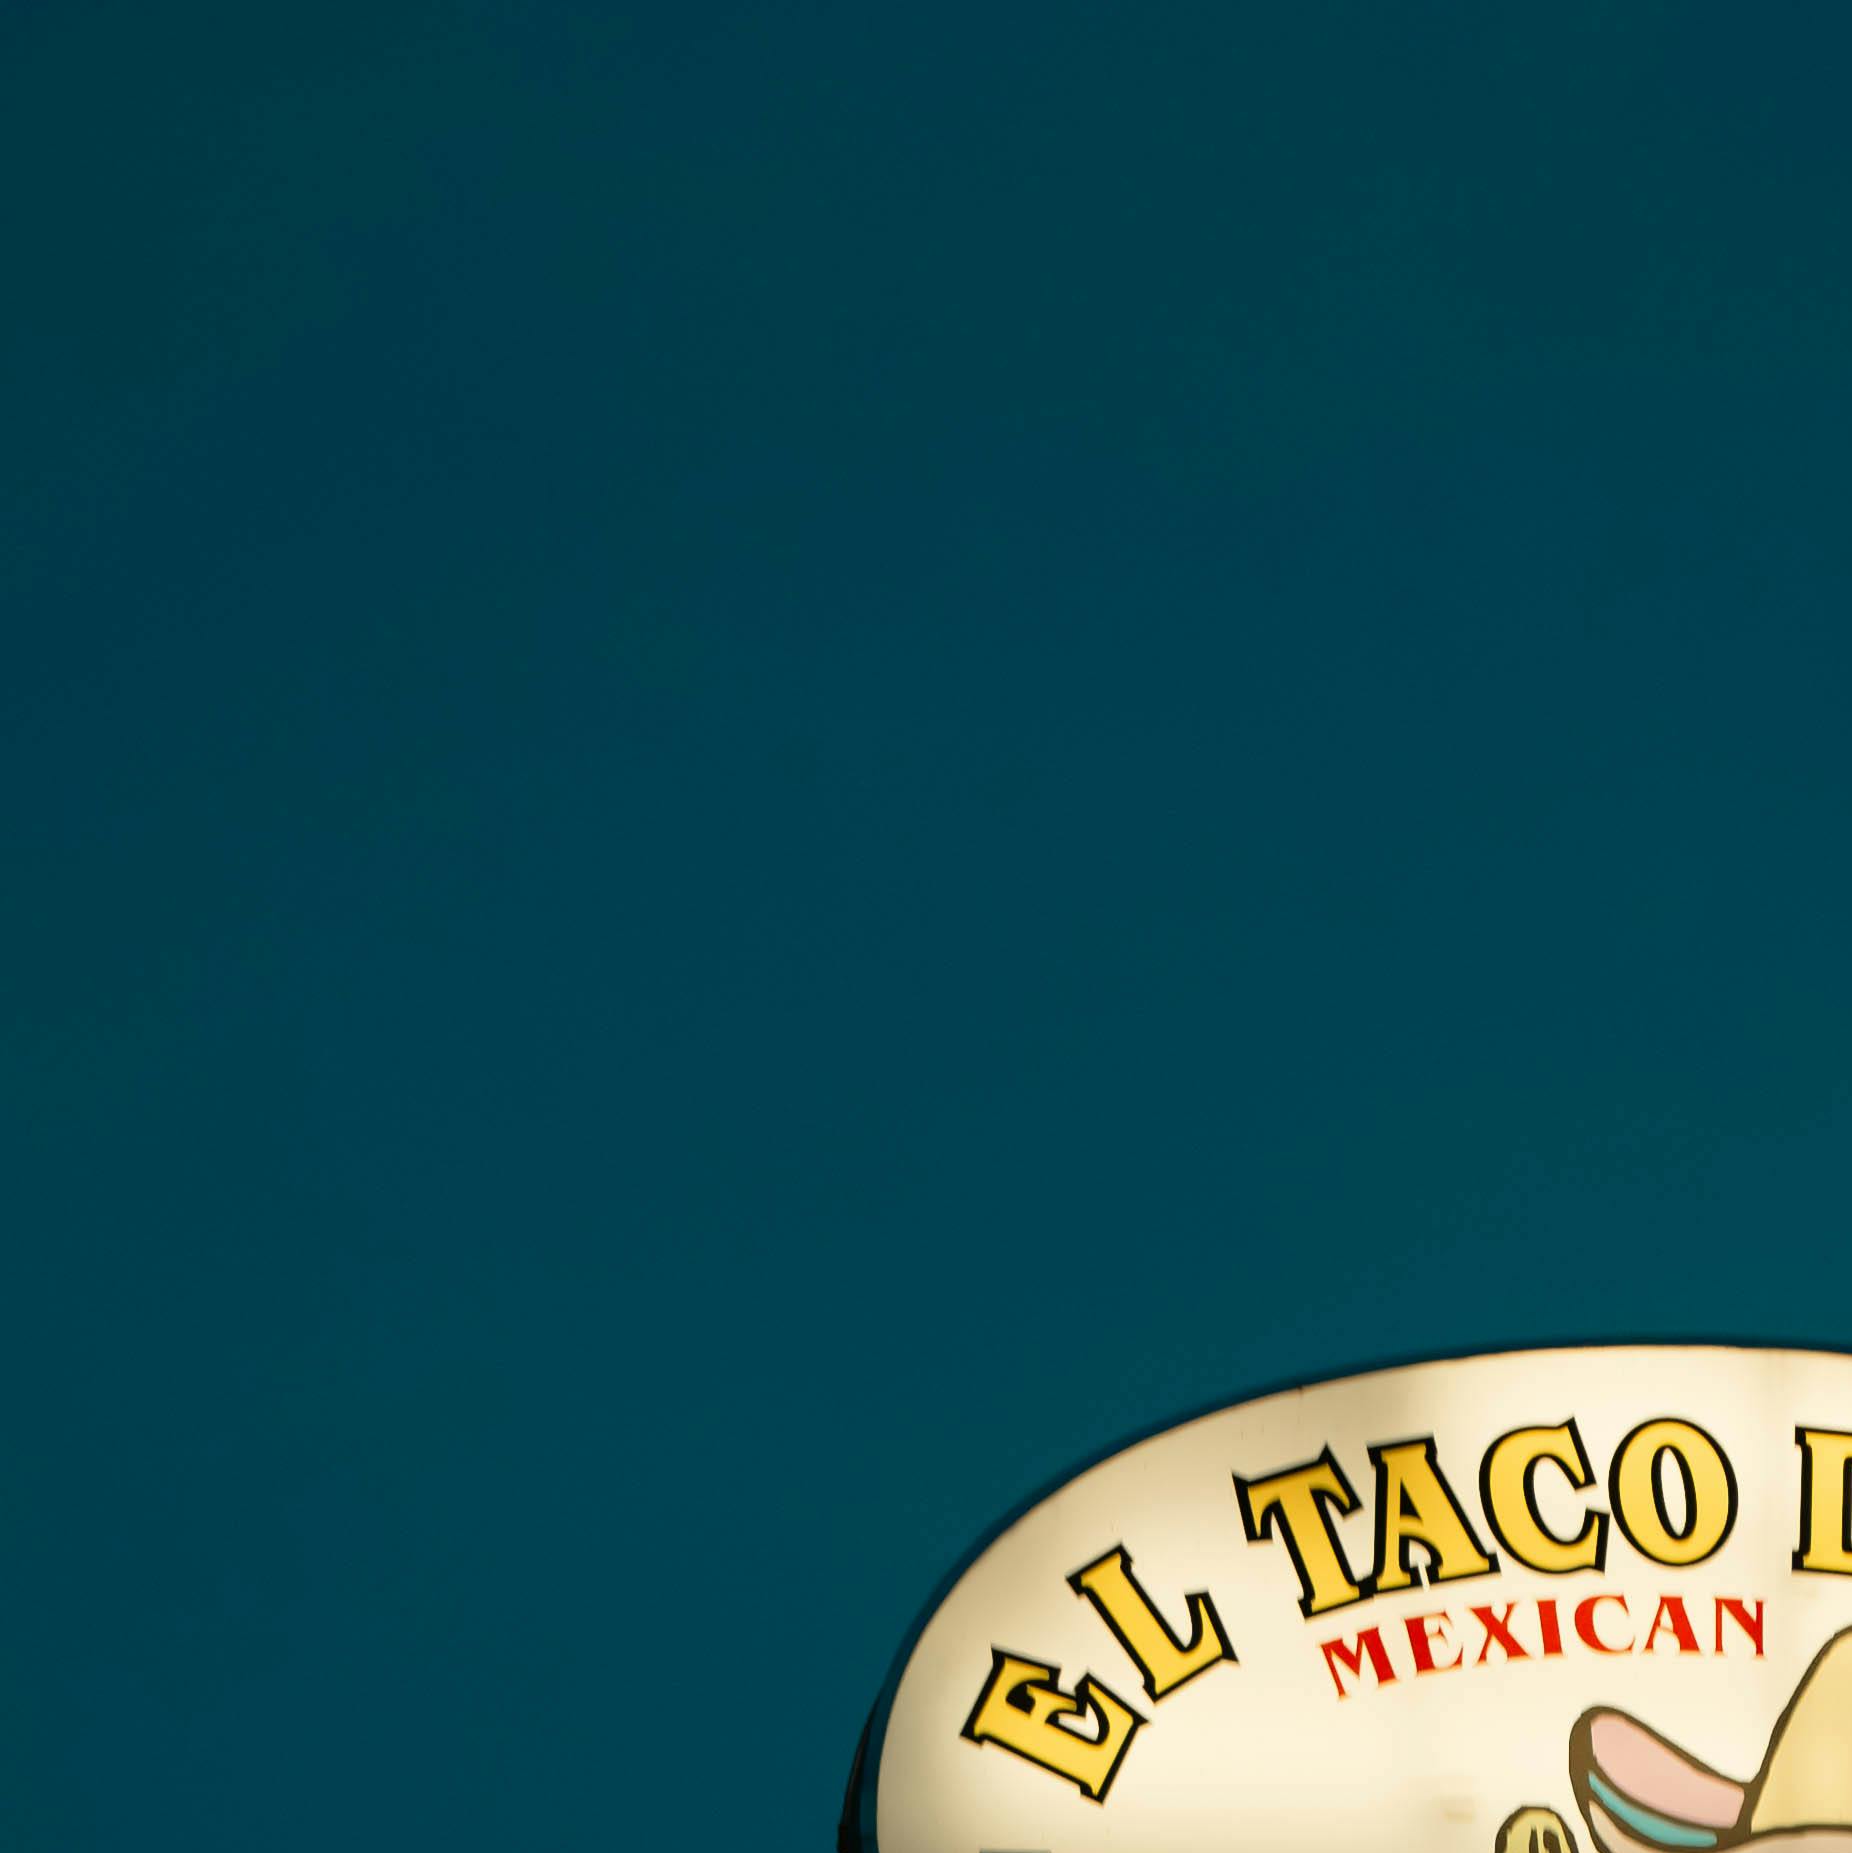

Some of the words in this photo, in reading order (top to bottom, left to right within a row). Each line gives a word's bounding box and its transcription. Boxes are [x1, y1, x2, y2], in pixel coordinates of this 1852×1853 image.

[960, 1543, 1240, 1806] EL
[1231, 1416, 1739, 1621] TACO
[1320, 1593, 1767, 1702] MEXICAN
